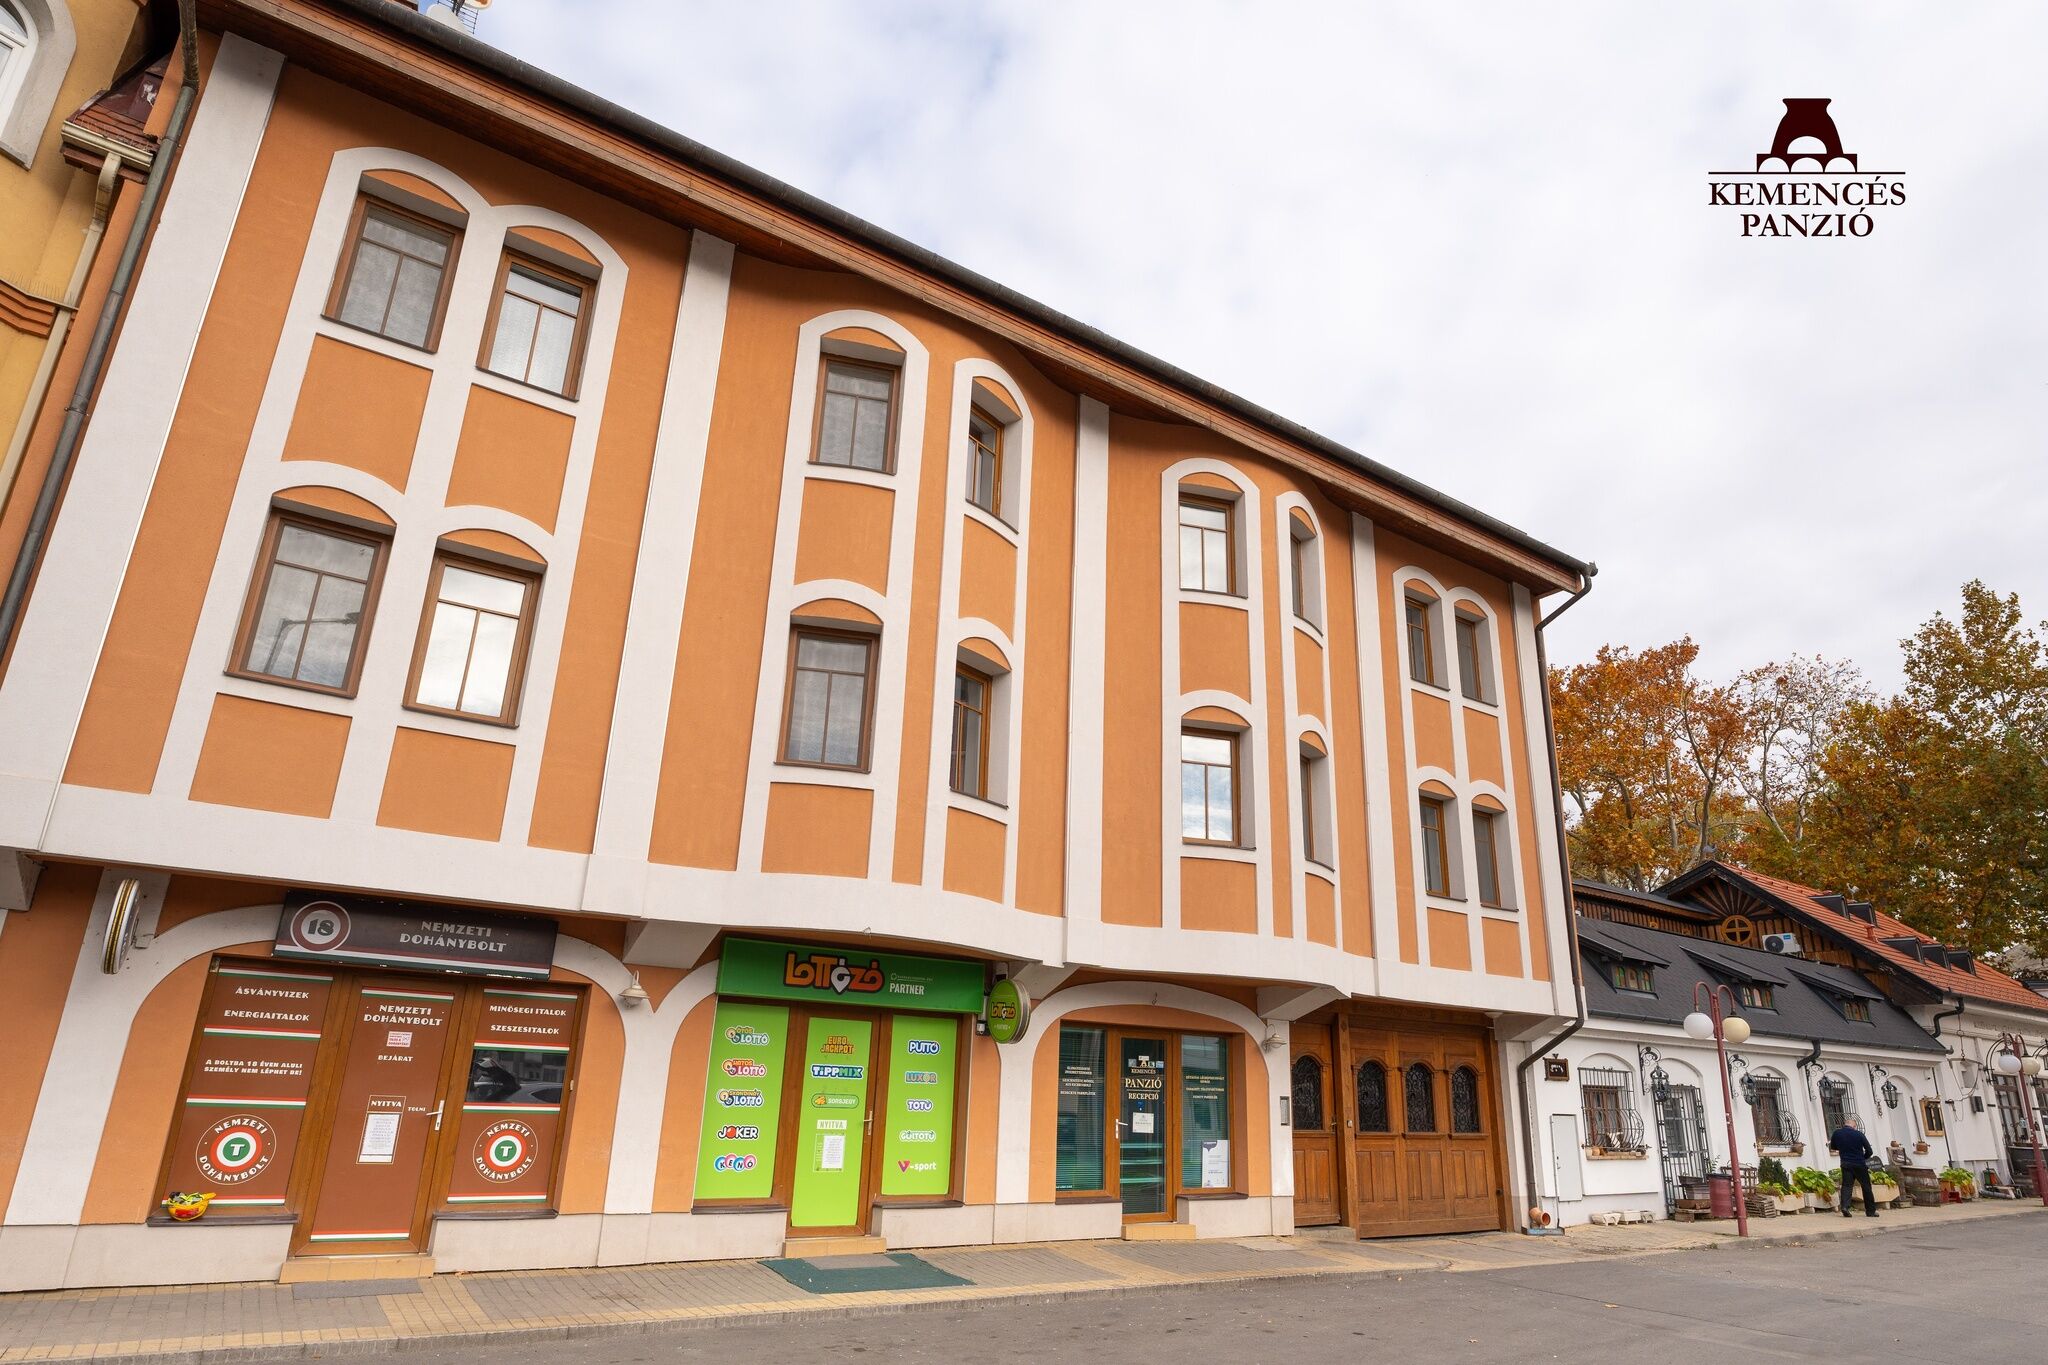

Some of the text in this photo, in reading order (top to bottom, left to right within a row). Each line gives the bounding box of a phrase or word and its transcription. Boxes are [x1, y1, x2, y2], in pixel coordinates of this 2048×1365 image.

[307, 919, 335, 936] 18
[421, 920, 492, 937] NEMZETI
[400, 933, 507, 953] DOHÁNYBOLT
[235, 986, 309, 999] ÁSVÁNYVIZEK
[889, 982, 925, 995] PARTNER
[224, 1009, 310, 1021] ENERGIAITALOK
[379, 1005, 432, 1015] NEMZETI
[535, 1008, 567, 1016] ITALOK
[363, 1014, 443, 1026] DOHÁNYBOLT
[490, 1024, 560, 1035] SZESZESITALOK
[740, 1034, 769, 1045] LOTTÓ
[828, 1036, 848, 1045] EURO
[821, 1045, 853, 1054] JACKPOT
[378, 1054, 413, 1062] BEJÁRAT
[738, 1066, 766, 1076] LOTTÓ
[906, 1073, 937, 1082] LUXOR
[1125, 1077, 1162, 1089] PANZIÓ
[734, 1095, 763, 1105] LOTTÓ
[1128, 1091, 1159, 1099] RECEPCIÓ
[214, 1118, 268, 1134] NEMZETI
[486, 1123, 530, 1137] NEMZETI
[718, 1126, 758, 1139] JOKER
[230, 1143, 245, 1157] T
[500, 1146, 513, 1157] T
[200, 1155, 269, 1181] DOHÁNYBOLT
[476, 1156, 532, 1179] DOHÁNYBOLT
[717, 1157, 755, 1170] KENÓ
